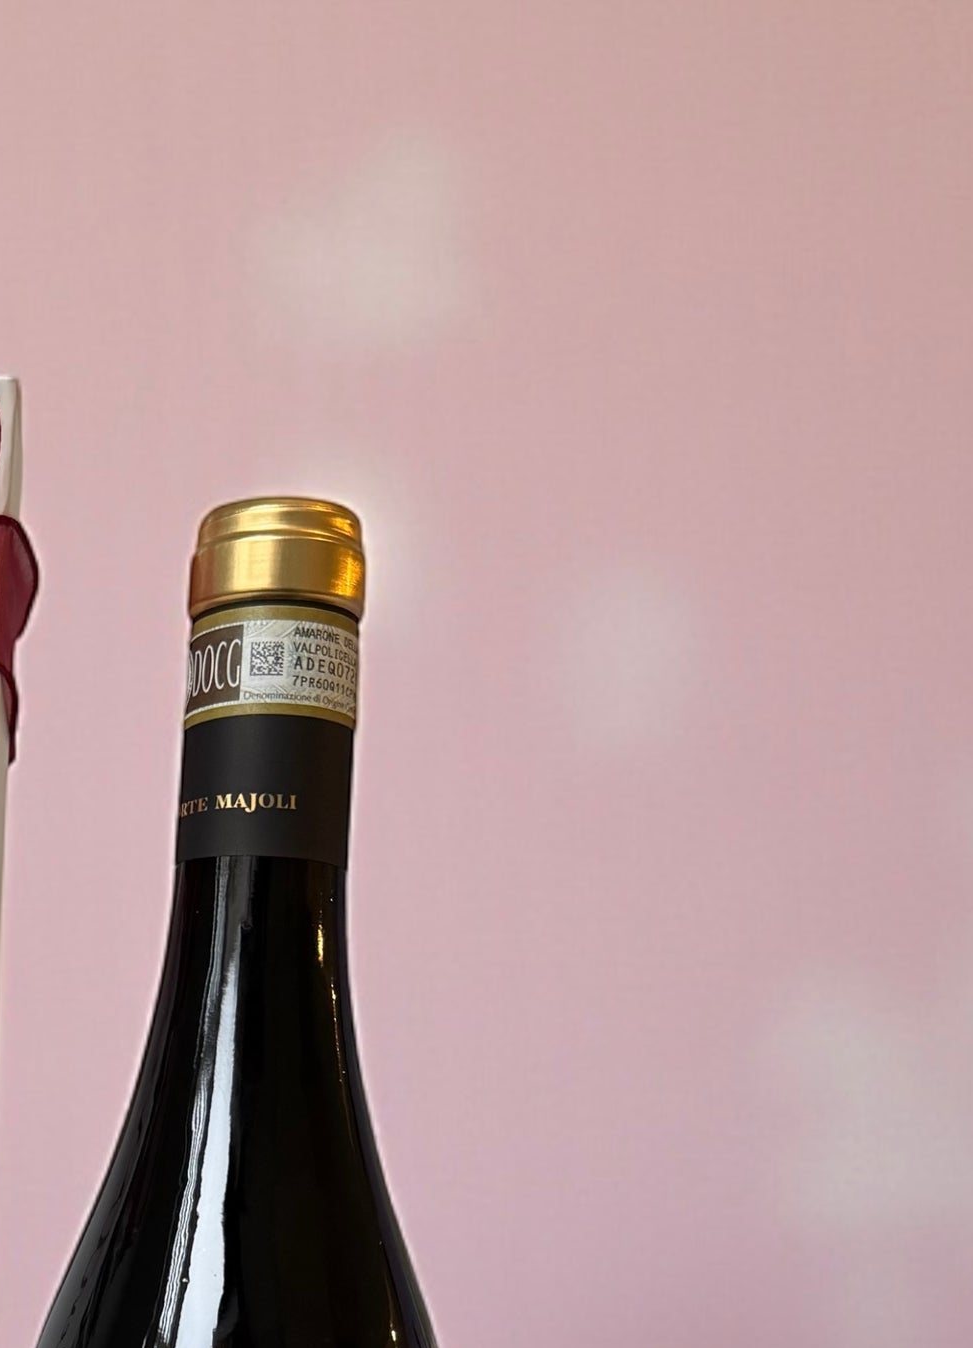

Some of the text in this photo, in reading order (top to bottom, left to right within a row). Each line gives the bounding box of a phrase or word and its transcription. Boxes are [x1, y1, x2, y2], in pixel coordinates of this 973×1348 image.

[294, 627, 340, 644] AMARONE
[192, 638, 241, 697] DOCG
[243, 690, 311, 702] Denominazione
[313, 693, 320, 703] di
[179, 793, 297, 818] RTE MAJOLI
